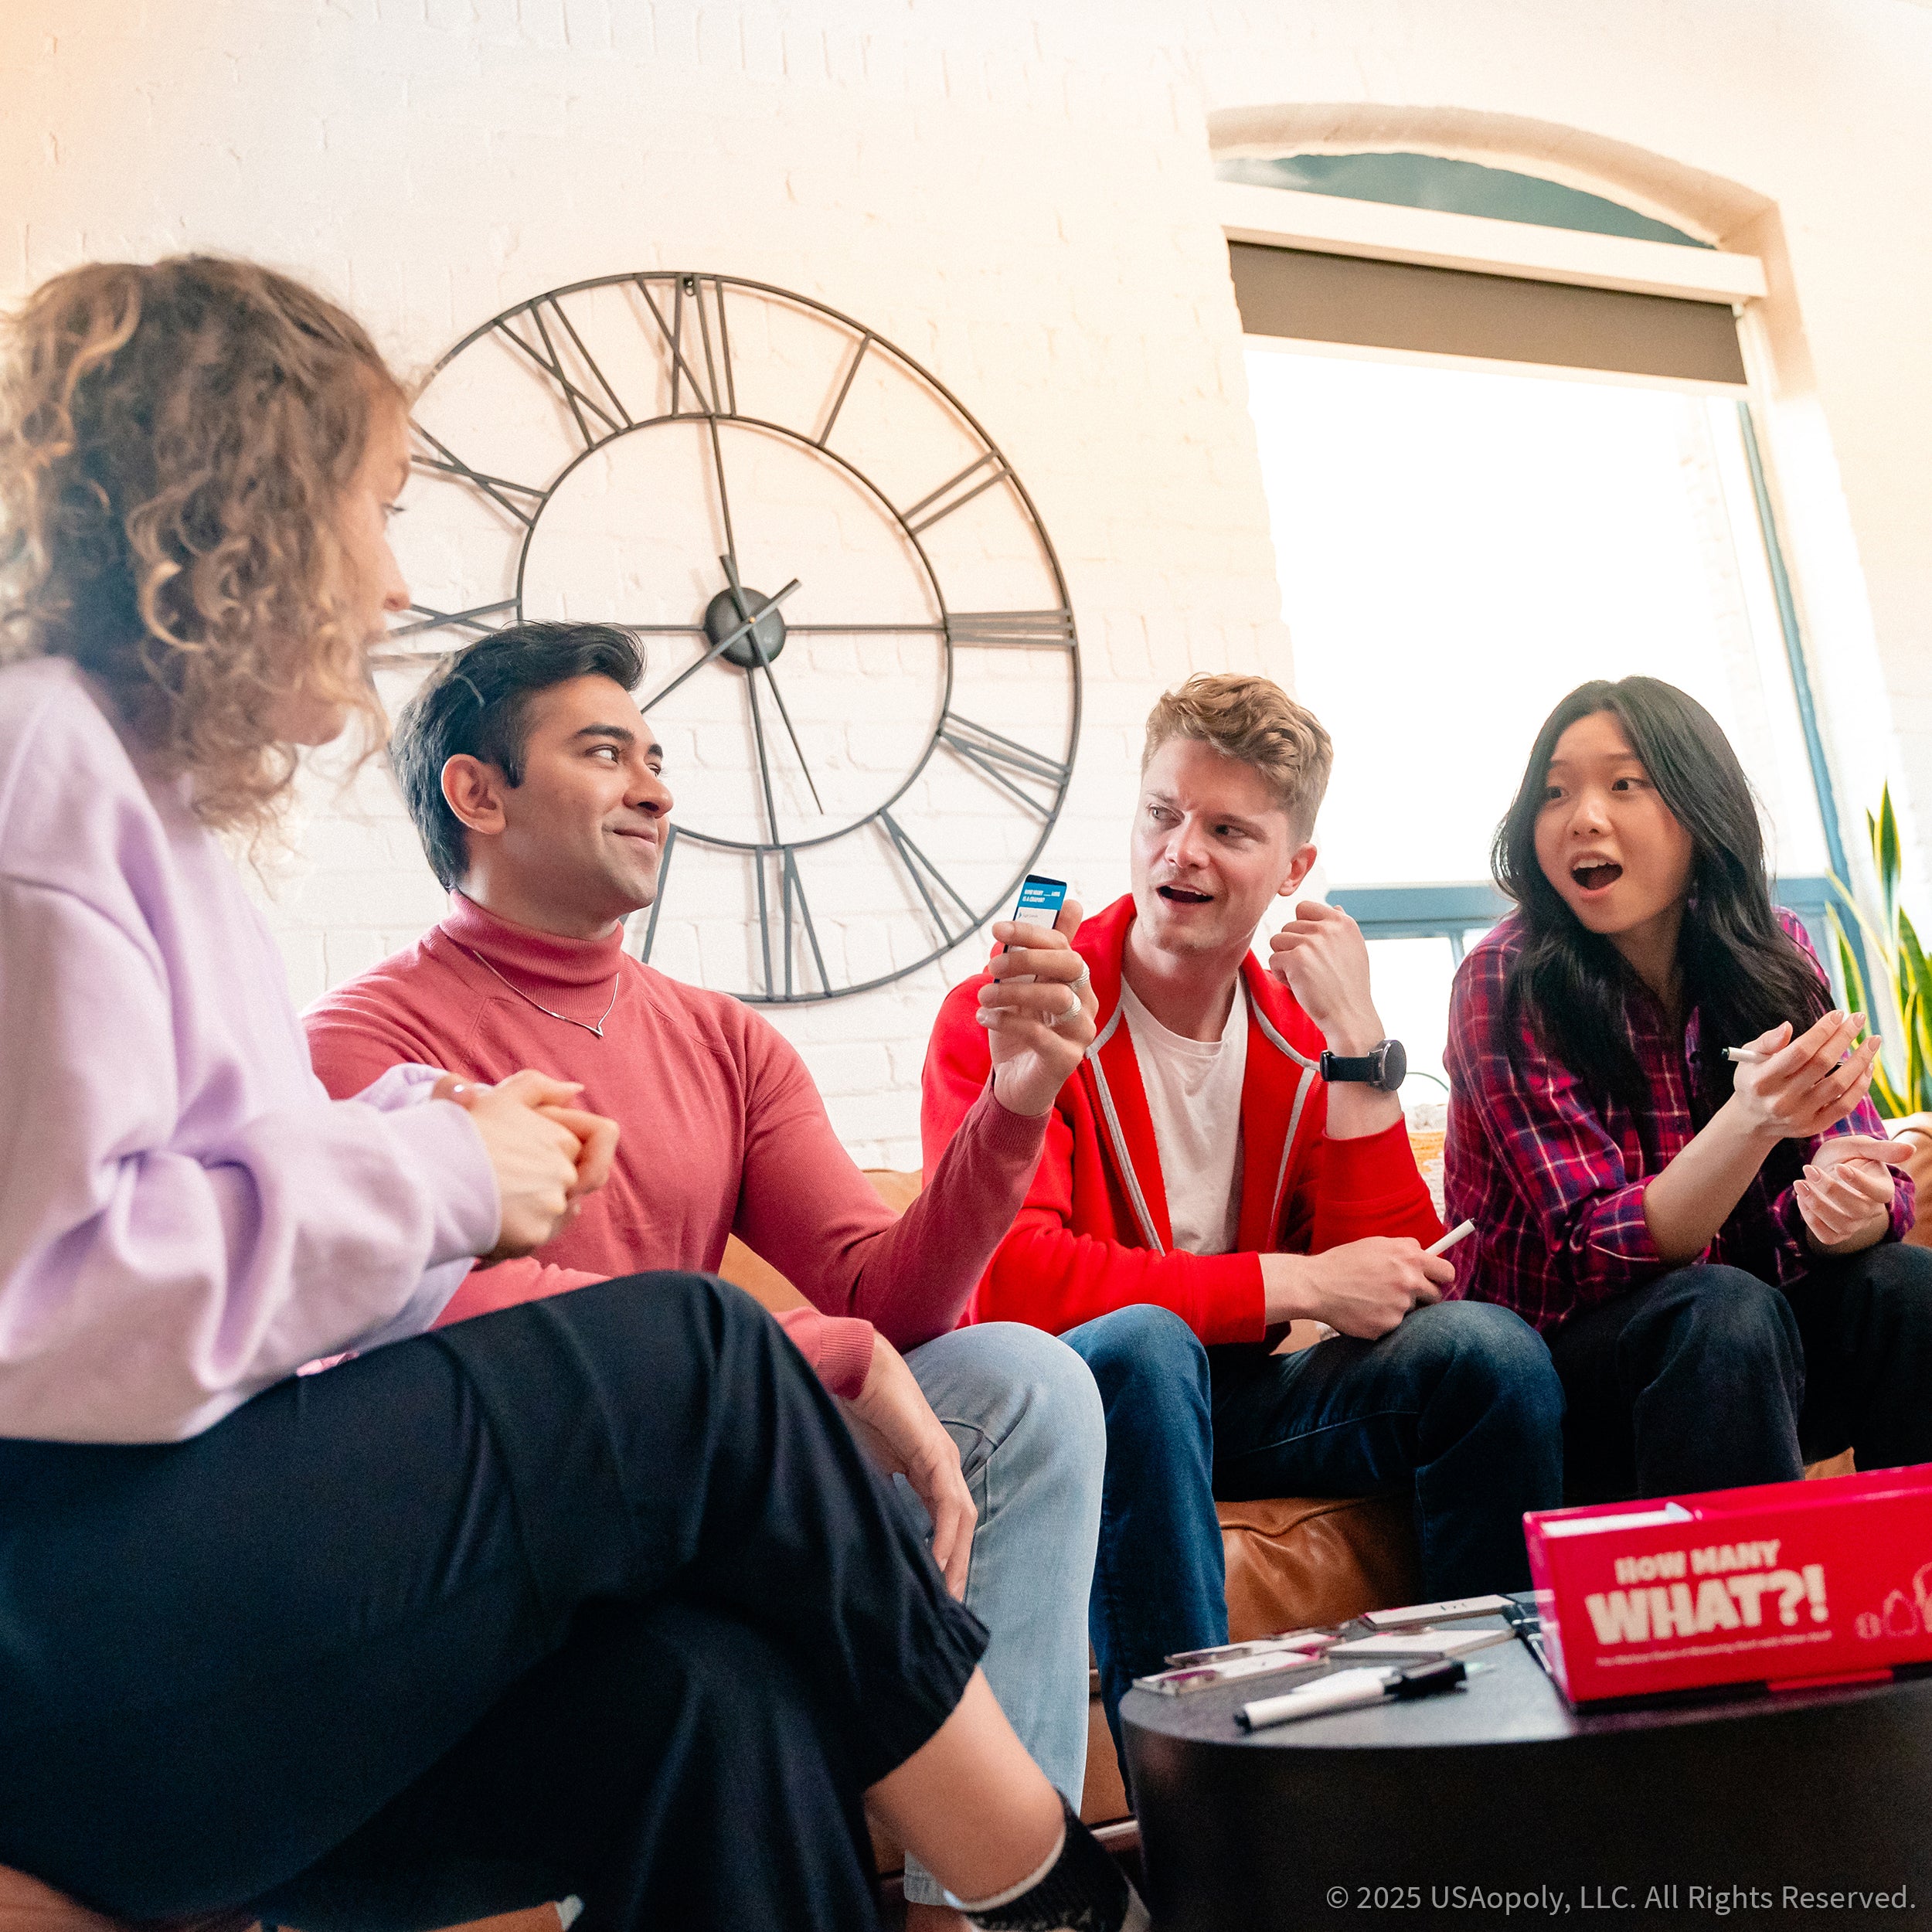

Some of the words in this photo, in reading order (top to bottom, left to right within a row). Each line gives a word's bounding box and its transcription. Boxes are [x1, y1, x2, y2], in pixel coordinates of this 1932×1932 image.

[1614, 1549, 1688, 1585] HOW
[1690, 1539, 1781, 1576] MANY
[1584, 1564, 1830, 1646] WHAT?!
